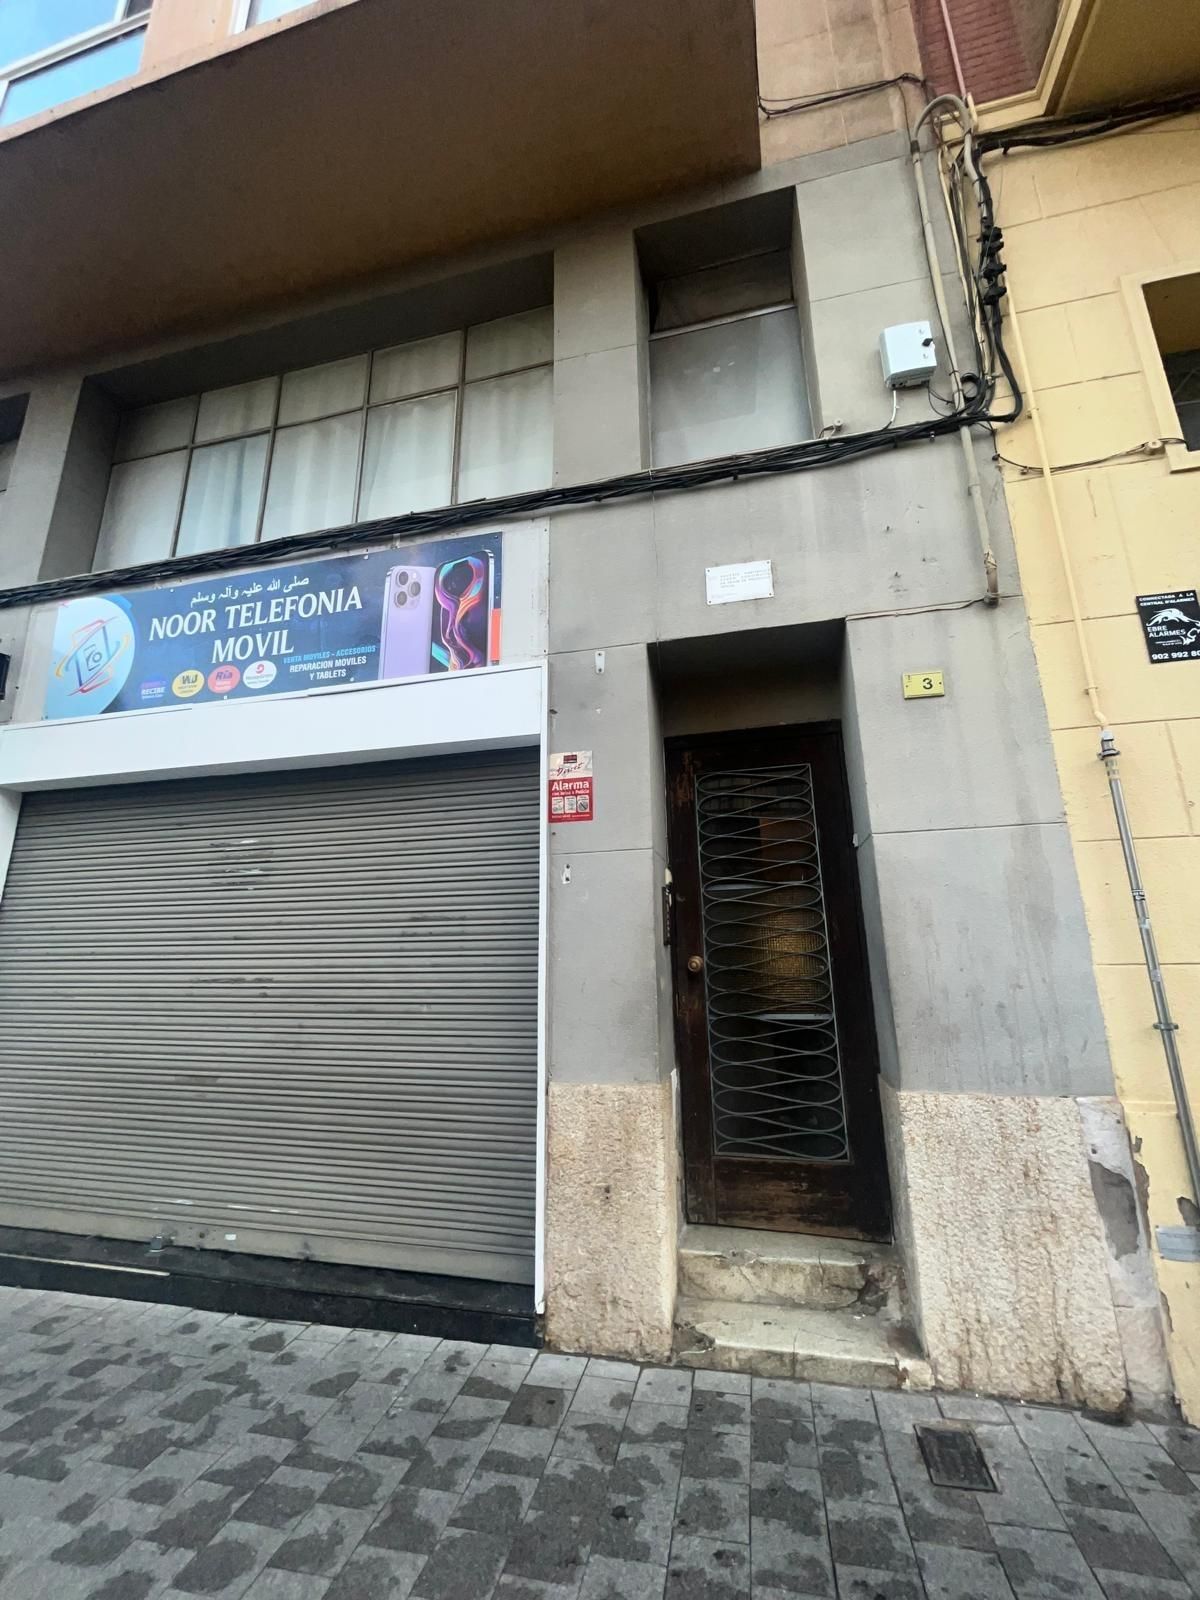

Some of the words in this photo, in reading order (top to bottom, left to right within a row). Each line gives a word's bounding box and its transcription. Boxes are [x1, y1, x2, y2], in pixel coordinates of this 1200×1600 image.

[149, 609, 217, 641] NOOR
[225, 586, 363, 629] TELEFONIA
[1149, 629, 1186, 638] ALARMES
[212, 629, 294, 664] MOVIL
[284, 656, 302, 664] VENTA
[303, 651, 331, 660] MOVILES
[336, 645, 376, 657] ACCESORIOS
[290, 660, 333, 672] REPARACION
[335, 656, 367, 667] MOVILES
[316, 669, 347, 679] TABLETS
[922, 678, 933, 690] 3
[552, 780, 589, 791] Alarma
